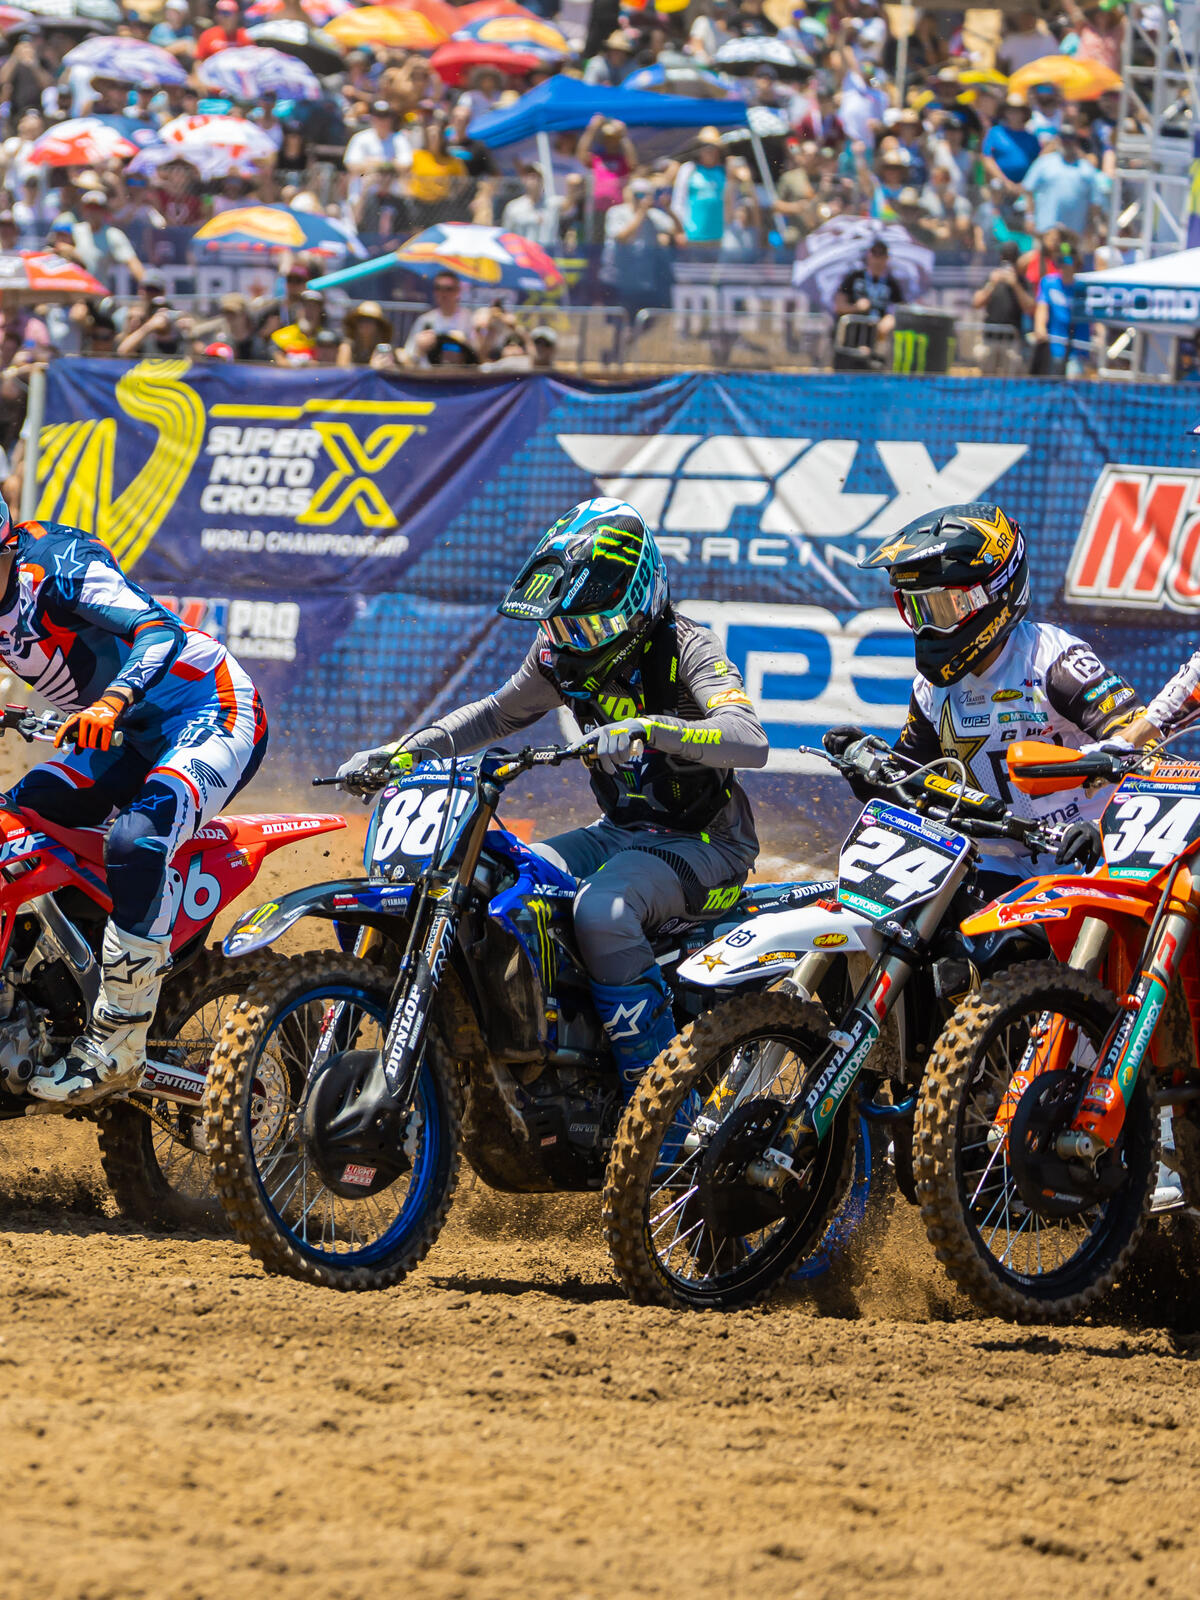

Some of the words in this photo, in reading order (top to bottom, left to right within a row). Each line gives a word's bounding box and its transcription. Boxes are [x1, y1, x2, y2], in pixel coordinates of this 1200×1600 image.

[205, 426, 322, 458] SUPER
[209, 456, 315, 488] MOTO
[200, 484, 314, 517] CROSS
[201, 528, 265, 552] WORLD
[266, 531, 410, 557] CHAMPIONSHIP
[656, 535, 866, 566] RACIN
[231, 600, 300, 640] PRO
[669, 656, 678, 683] THOR
[963, 714, 990, 727] WPS
[182, 765, 208, 805] HONDA
[1138, 782, 1196, 792] PROMOTOCROSS
[1155, 768, 1200, 778] RENTH
[193, 828, 228, 840] NDA
[262, 820, 321, 835] DUNLOP
[372, 788, 471, 861] 88
[880, 812, 942, 843] PROMOTOCROSS
[1103, 795, 1200, 867] 34
[840, 826, 954, 902] 24
[1119, 869, 1151, 878] MOTOREX
[387, 897, 408, 906] YAMAHA
[791, 880, 839, 899] DUNLO
[849, 894, 883, 915] MOTOREX
[385, 983, 421, 1078] DUNLOP
[1108, 982, 1145, 1064] DUNLP
[1127, 999, 1164, 1068] MOTOREX
[806, 1020, 863, 1110] DUNLP
[832, 1032, 877, 1101] MOTOREX
[341, 1173, 373, 1185] SPEED
